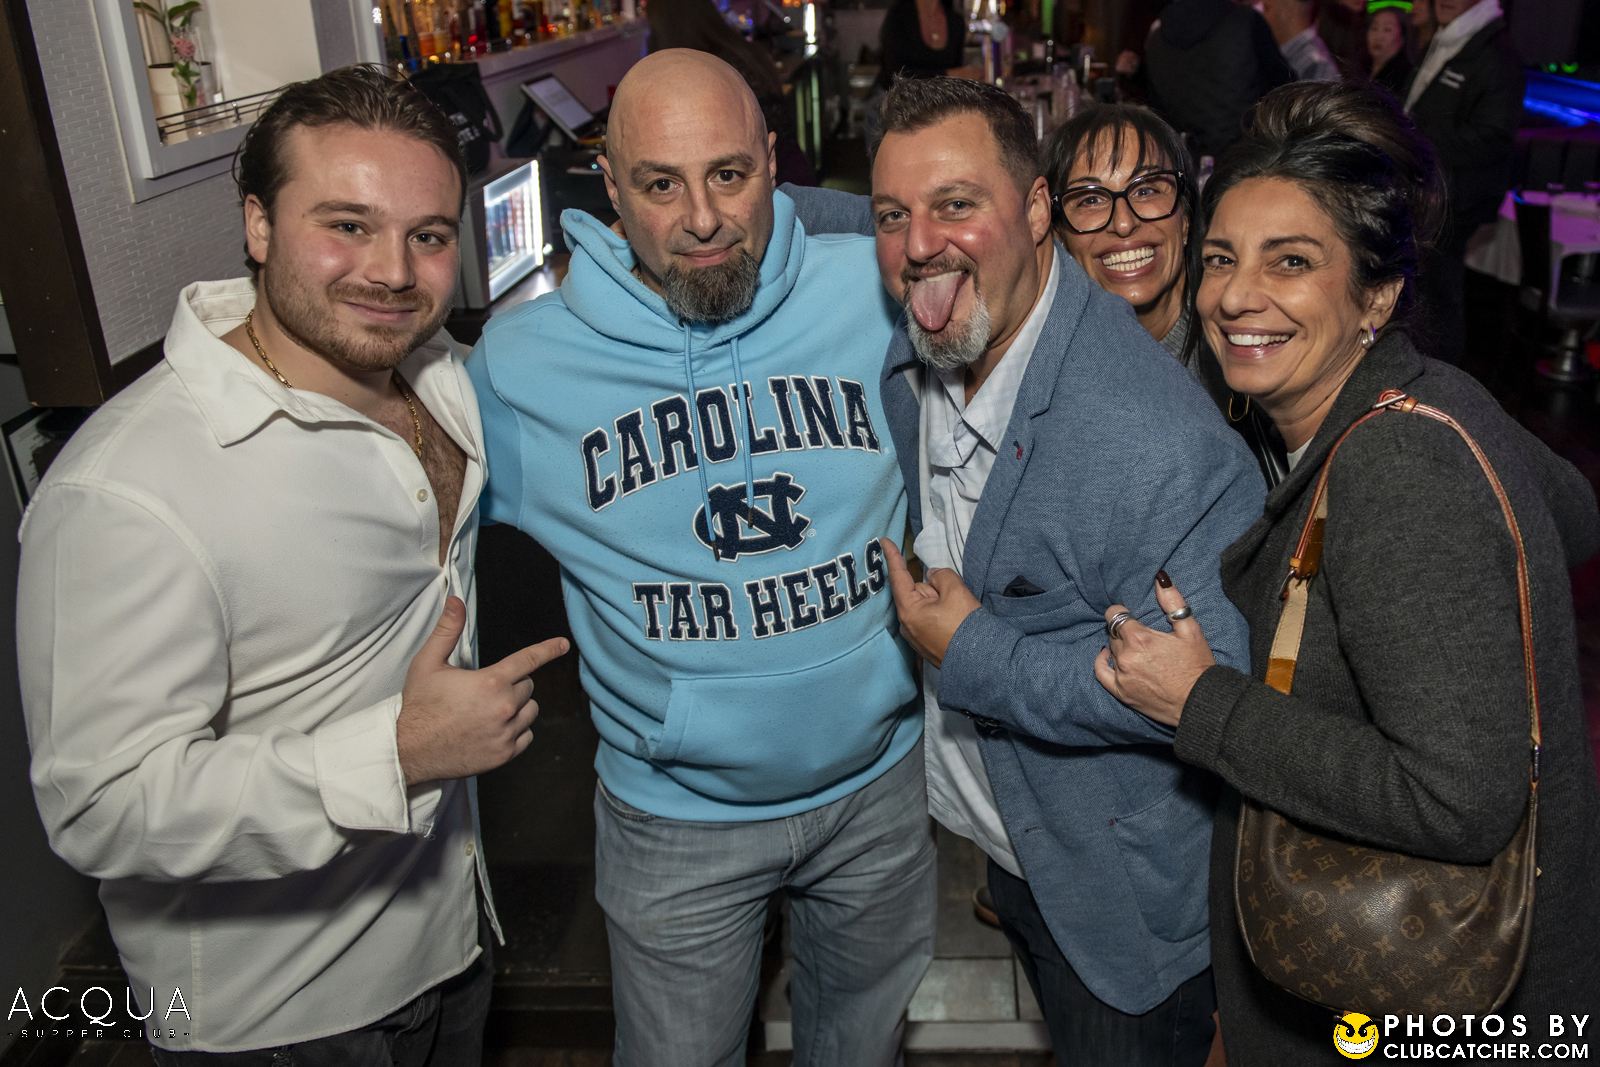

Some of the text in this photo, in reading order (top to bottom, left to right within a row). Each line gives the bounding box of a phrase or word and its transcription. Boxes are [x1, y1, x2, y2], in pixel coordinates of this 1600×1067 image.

[581, 375, 881, 512] CAROLINA
[632, 537, 888, 641] TAR HEELS
